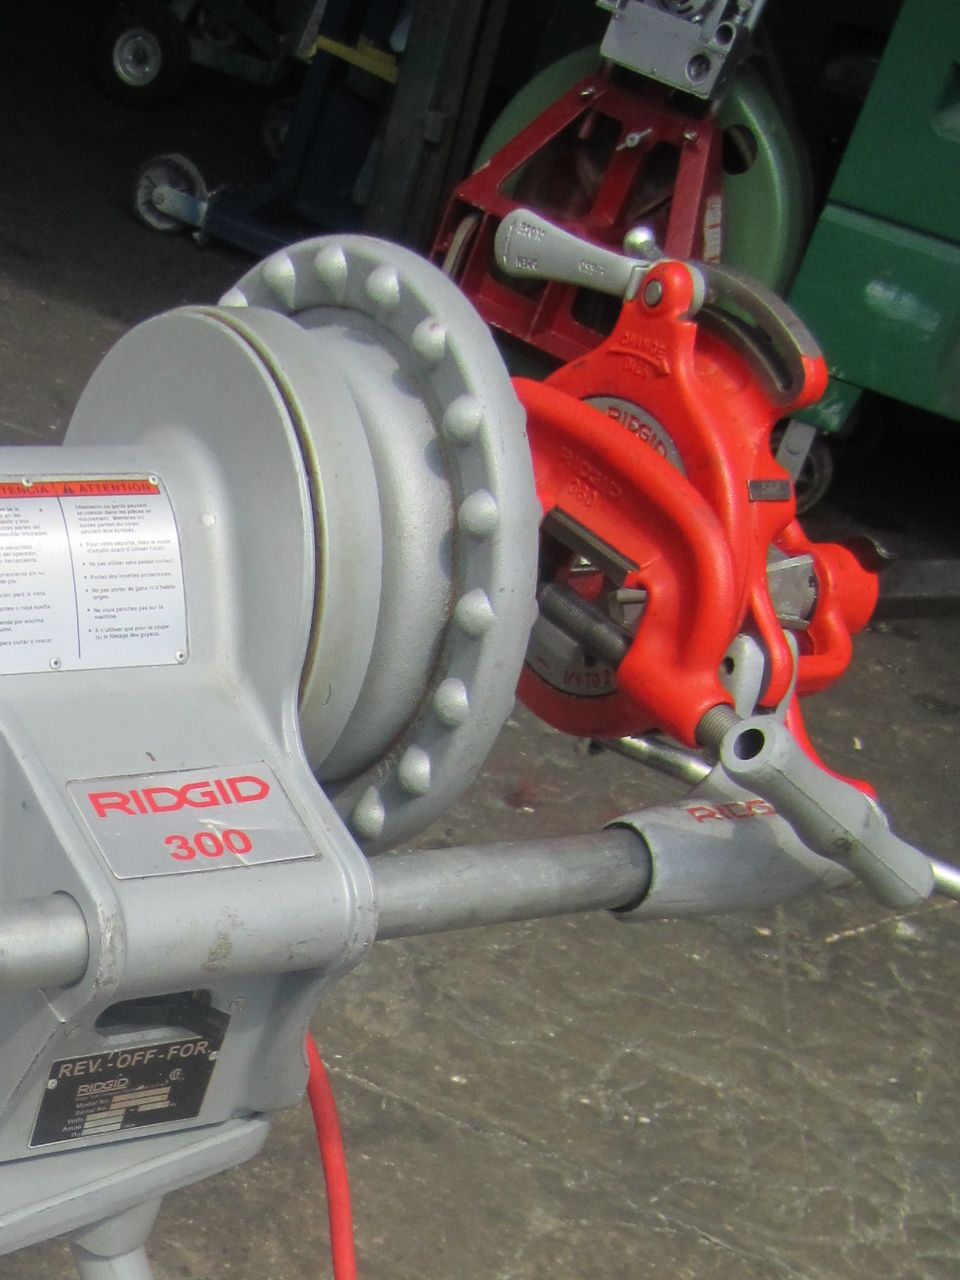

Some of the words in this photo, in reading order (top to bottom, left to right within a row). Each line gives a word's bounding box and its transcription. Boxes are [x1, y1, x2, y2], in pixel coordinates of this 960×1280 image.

[608, 407, 668, 458] RIDGID
[79, 481, 151, 494] ATTENTION
[87, 776, 270, 818] RIDGID
[164, 829, 253, 861] 300
[76, 1077, 129, 1095] RIDGID
